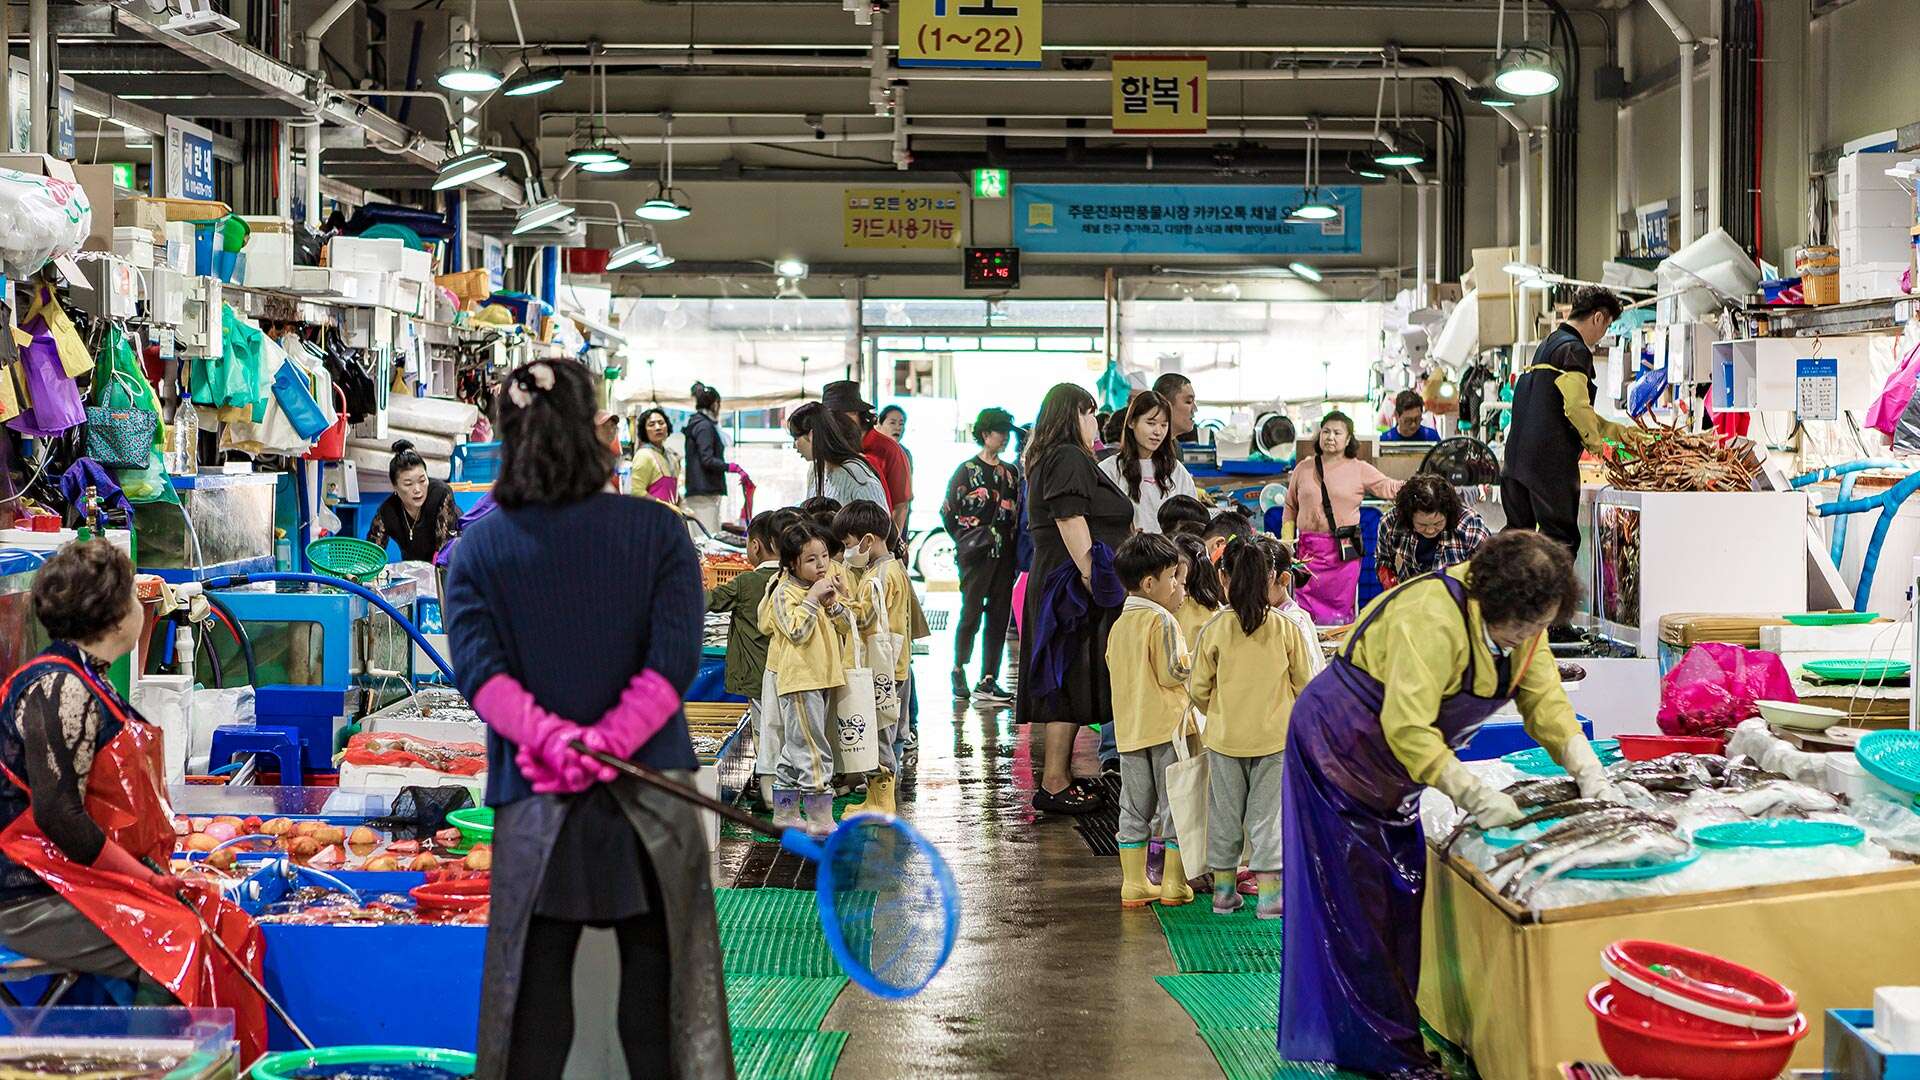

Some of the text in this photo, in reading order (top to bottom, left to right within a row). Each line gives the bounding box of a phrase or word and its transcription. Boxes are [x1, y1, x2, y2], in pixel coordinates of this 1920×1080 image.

[917, 24, 1023, 56] (1~22)
[873, 197, 933, 212] 모든 상가
[1193, 204, 1247, 221] 카카오톡
[1250, 205, 1278, 221] 채널
